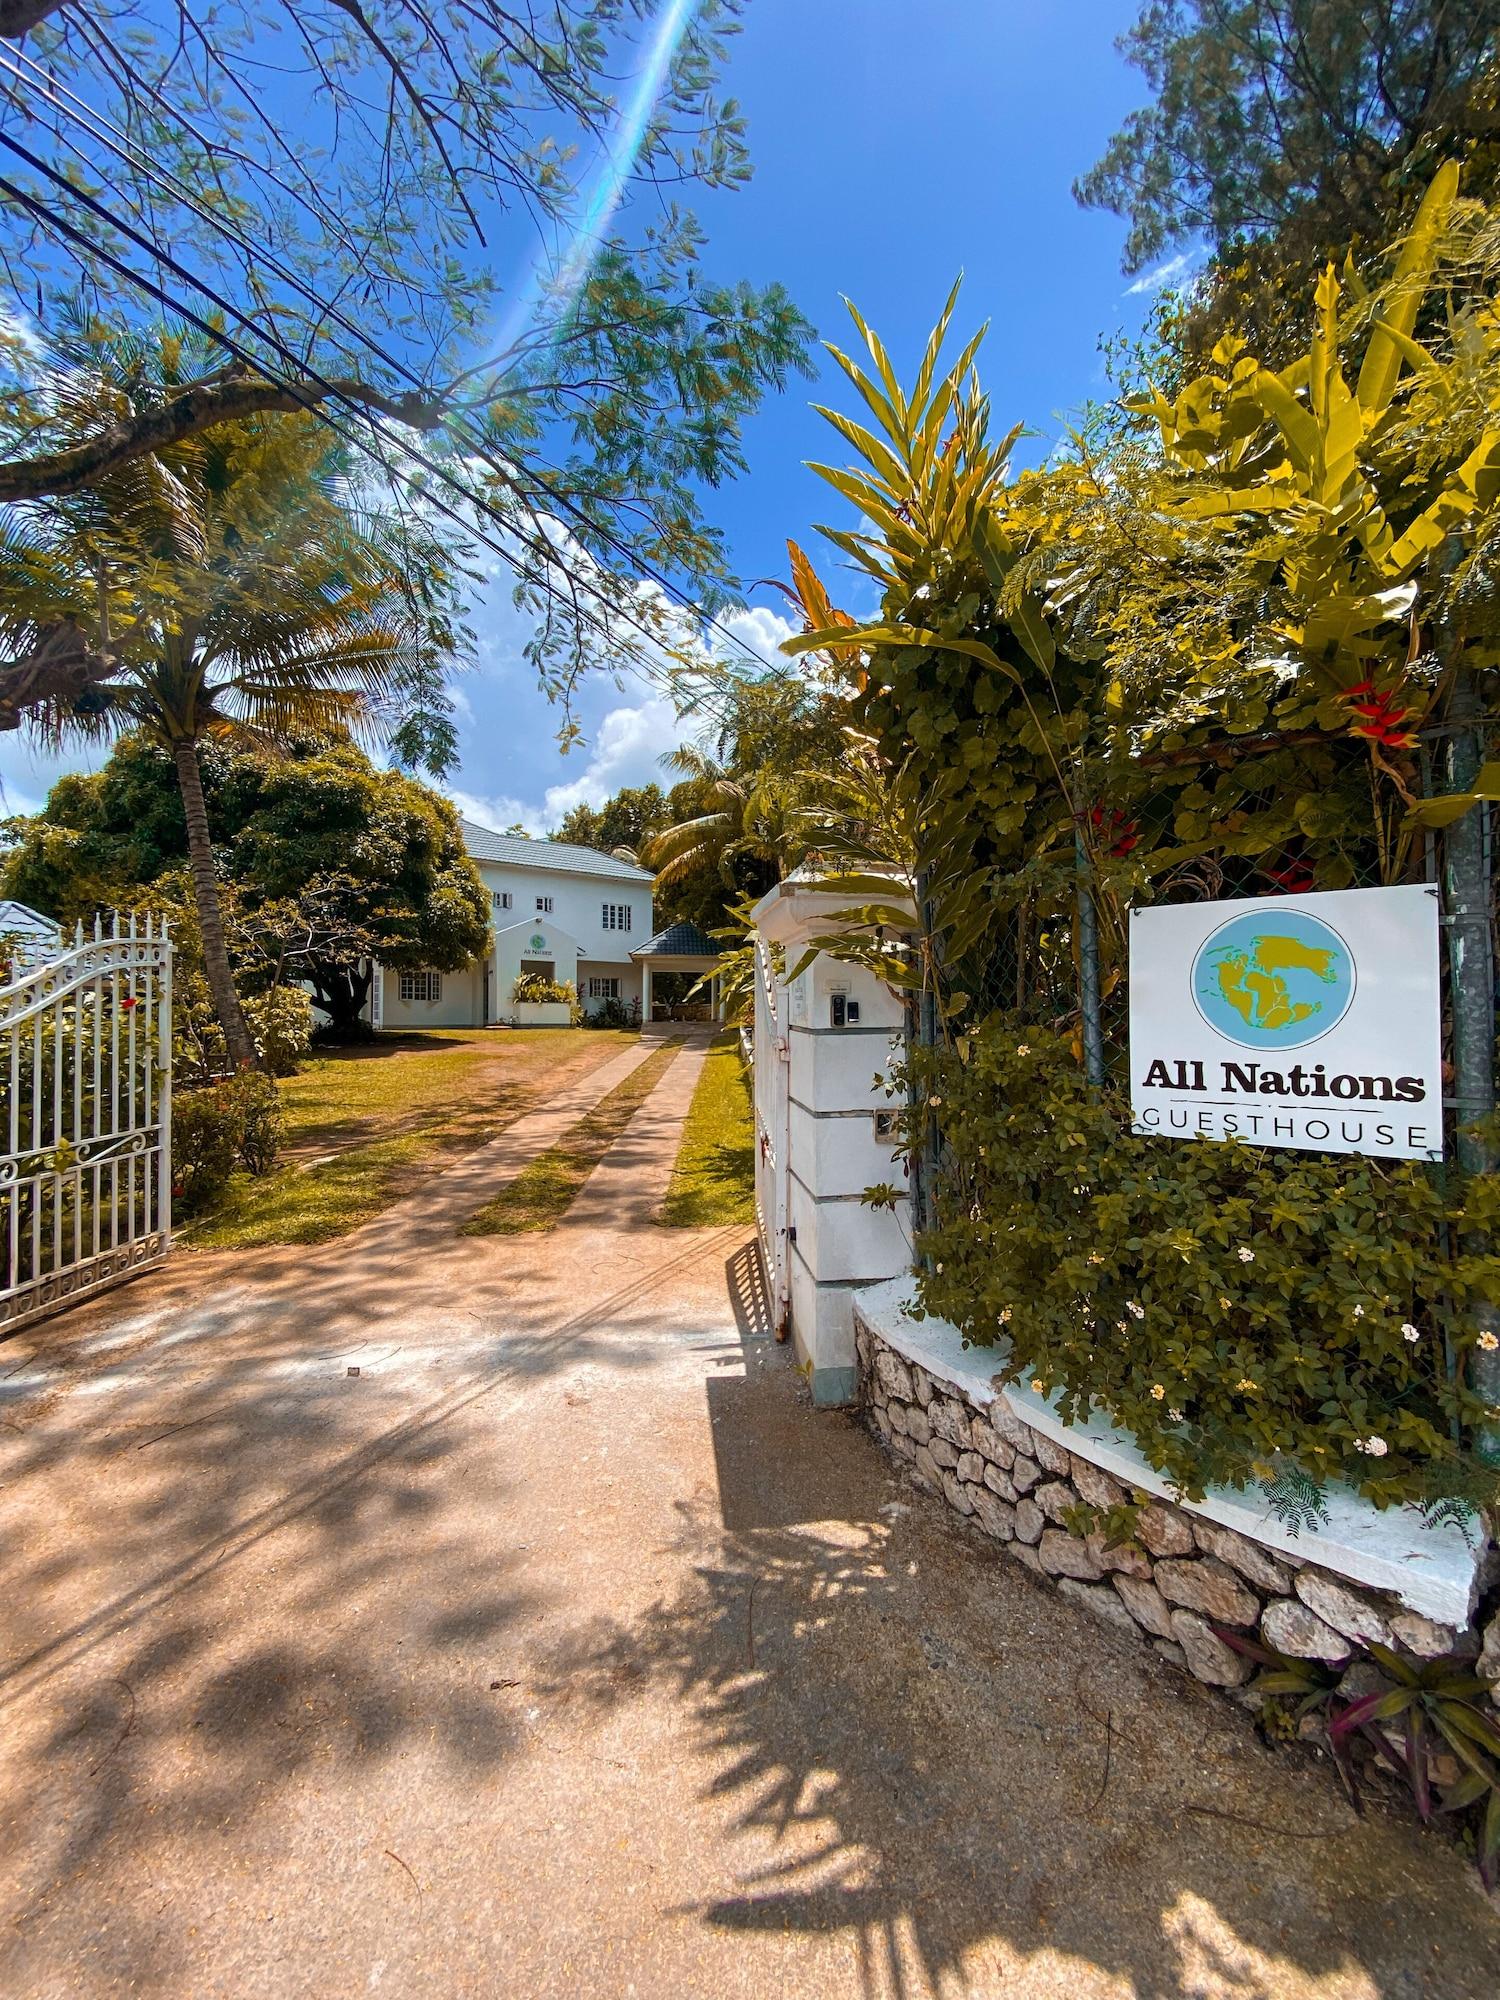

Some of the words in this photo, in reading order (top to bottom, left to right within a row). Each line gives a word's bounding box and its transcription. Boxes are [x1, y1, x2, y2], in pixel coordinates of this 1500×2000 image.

[1142, 1059, 1207, 1090] All
[1220, 1062, 1426, 1102] Nations
[1142, 1107, 1428, 1149] GUESTHOUSE
